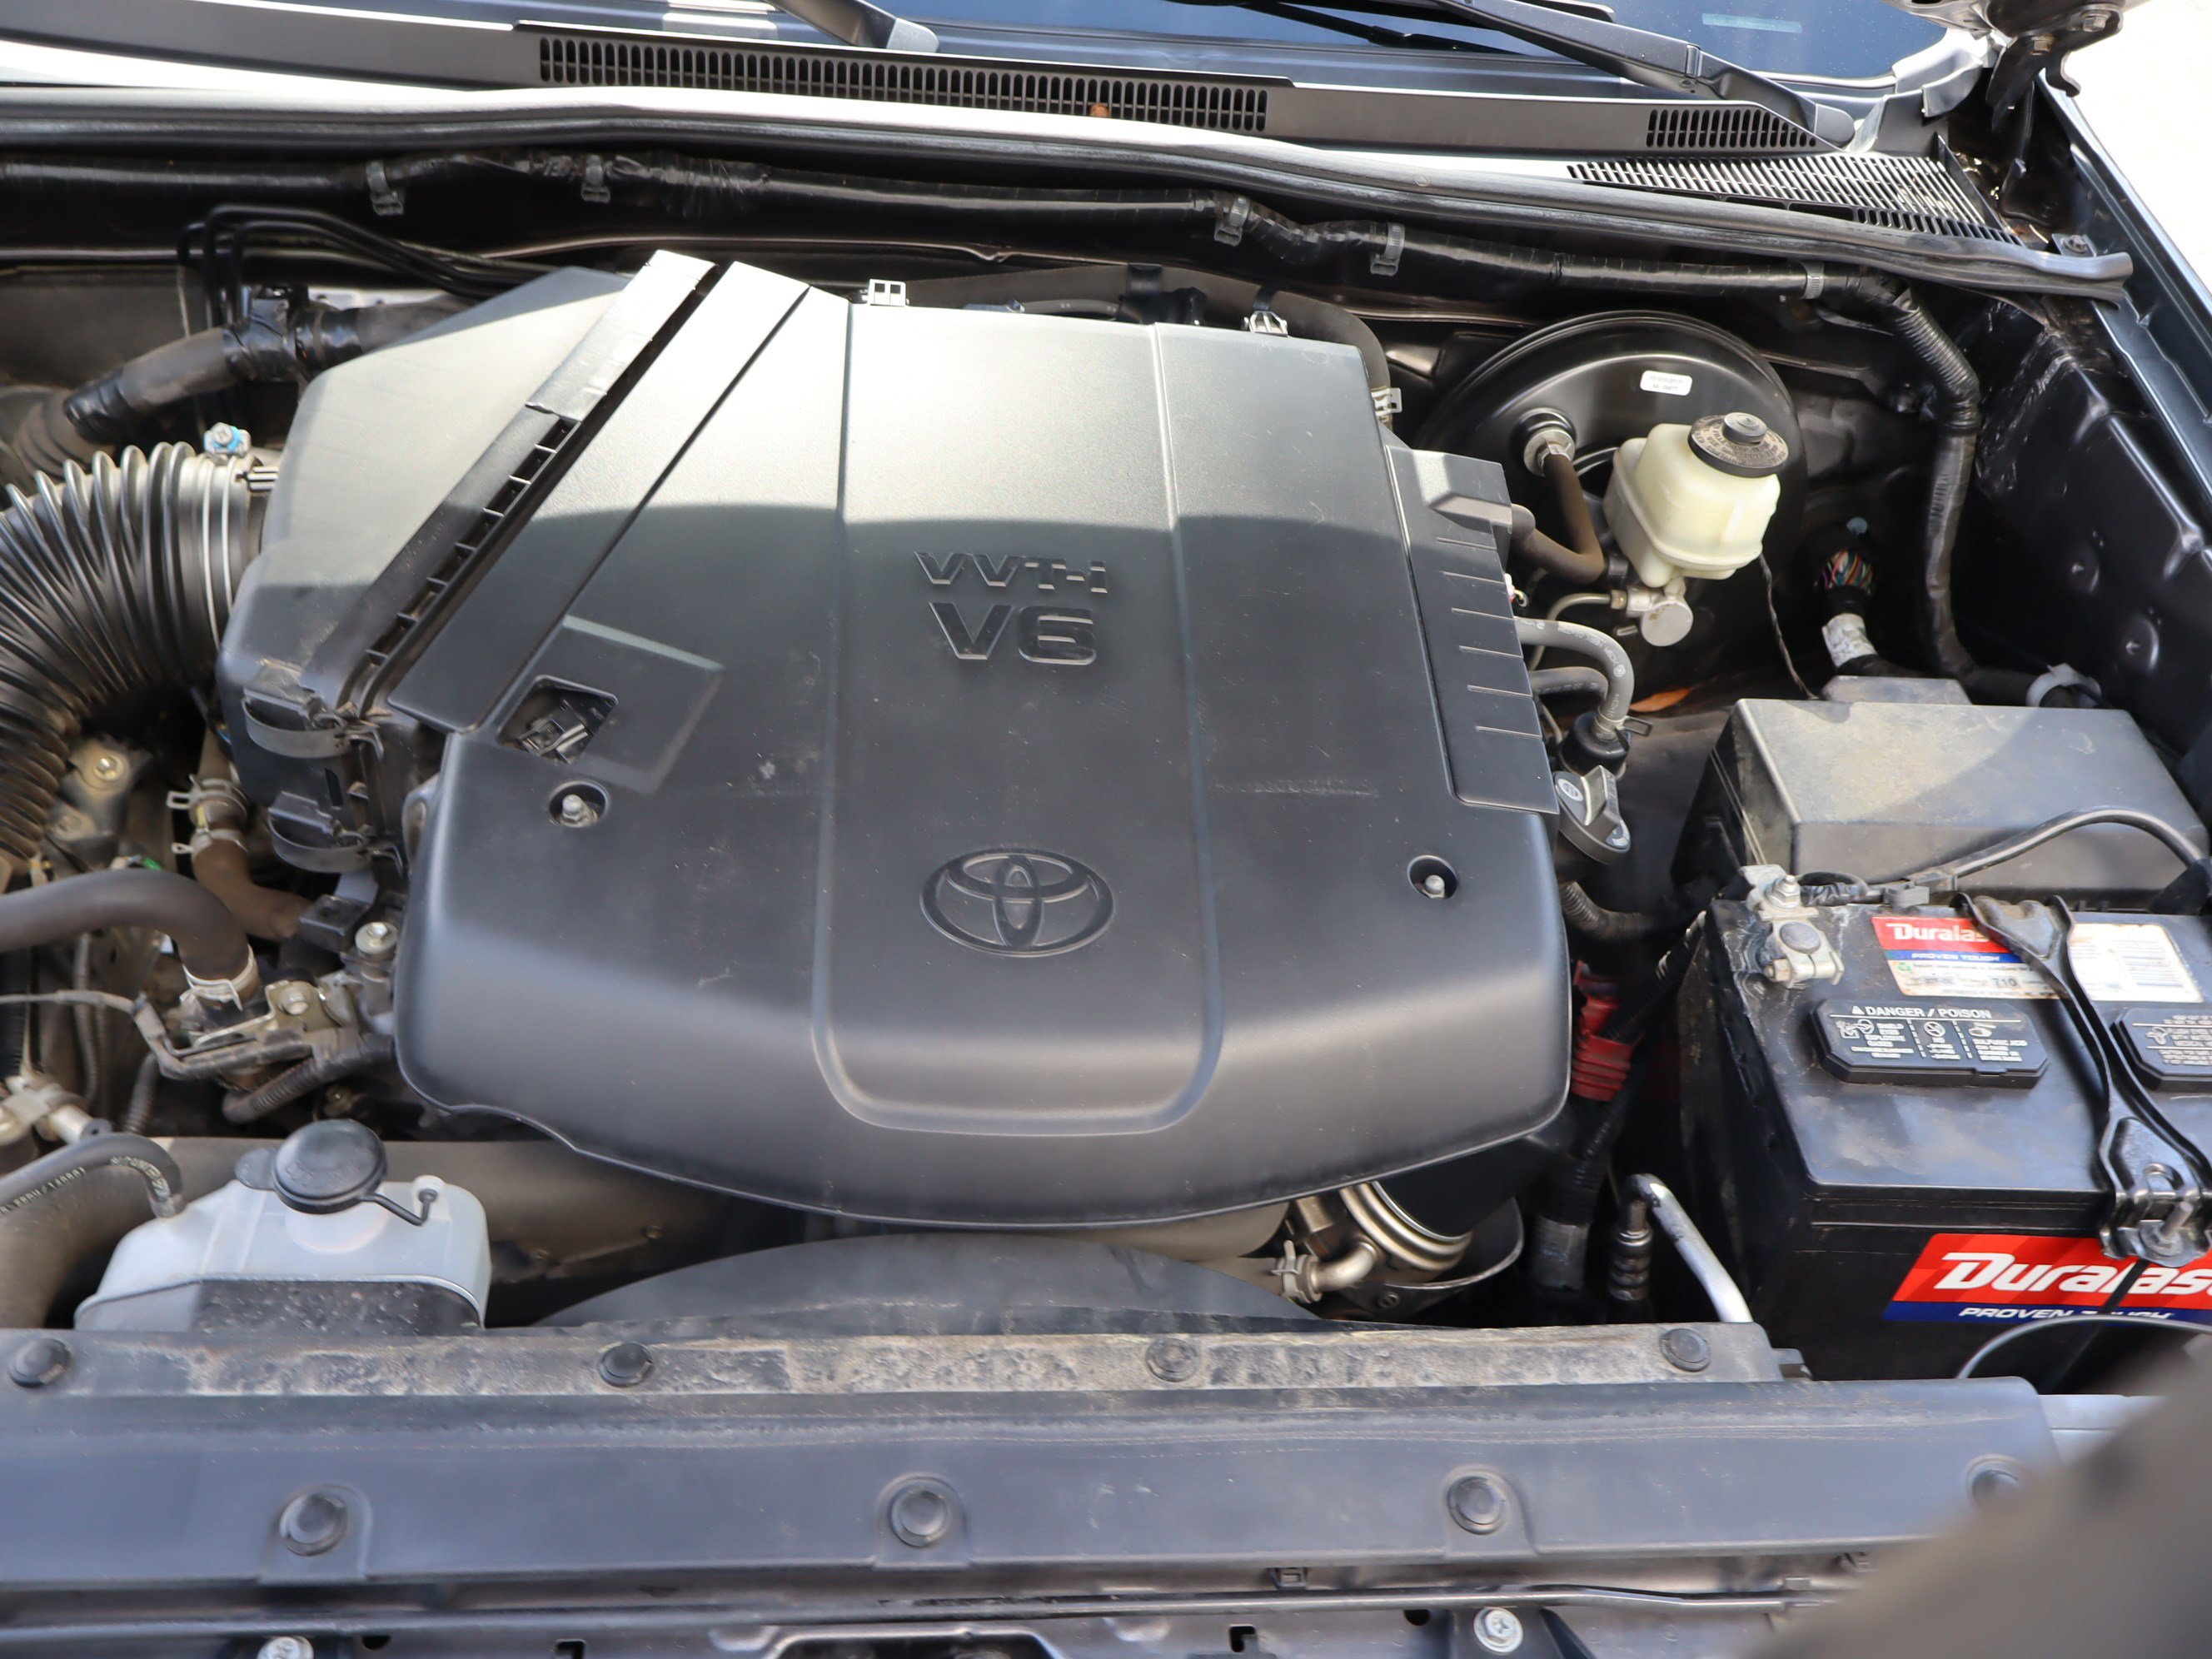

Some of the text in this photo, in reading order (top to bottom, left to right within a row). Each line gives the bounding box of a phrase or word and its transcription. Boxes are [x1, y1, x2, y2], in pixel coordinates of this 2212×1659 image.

[929, 601, 1097, 665] V6
[1886, 923, 1990, 942] Duralas
[1911, 952, 1959, 960] PROVEN
[1991, 977, 2017, 988] 710
[1864, 1006, 1926, 1018] DANGER
[1937, 1008, 1992, 1019] POISON
[1933, 1252, 2212, 1295] Duralas
[1958, 1307, 2074, 1319] PROVEN
